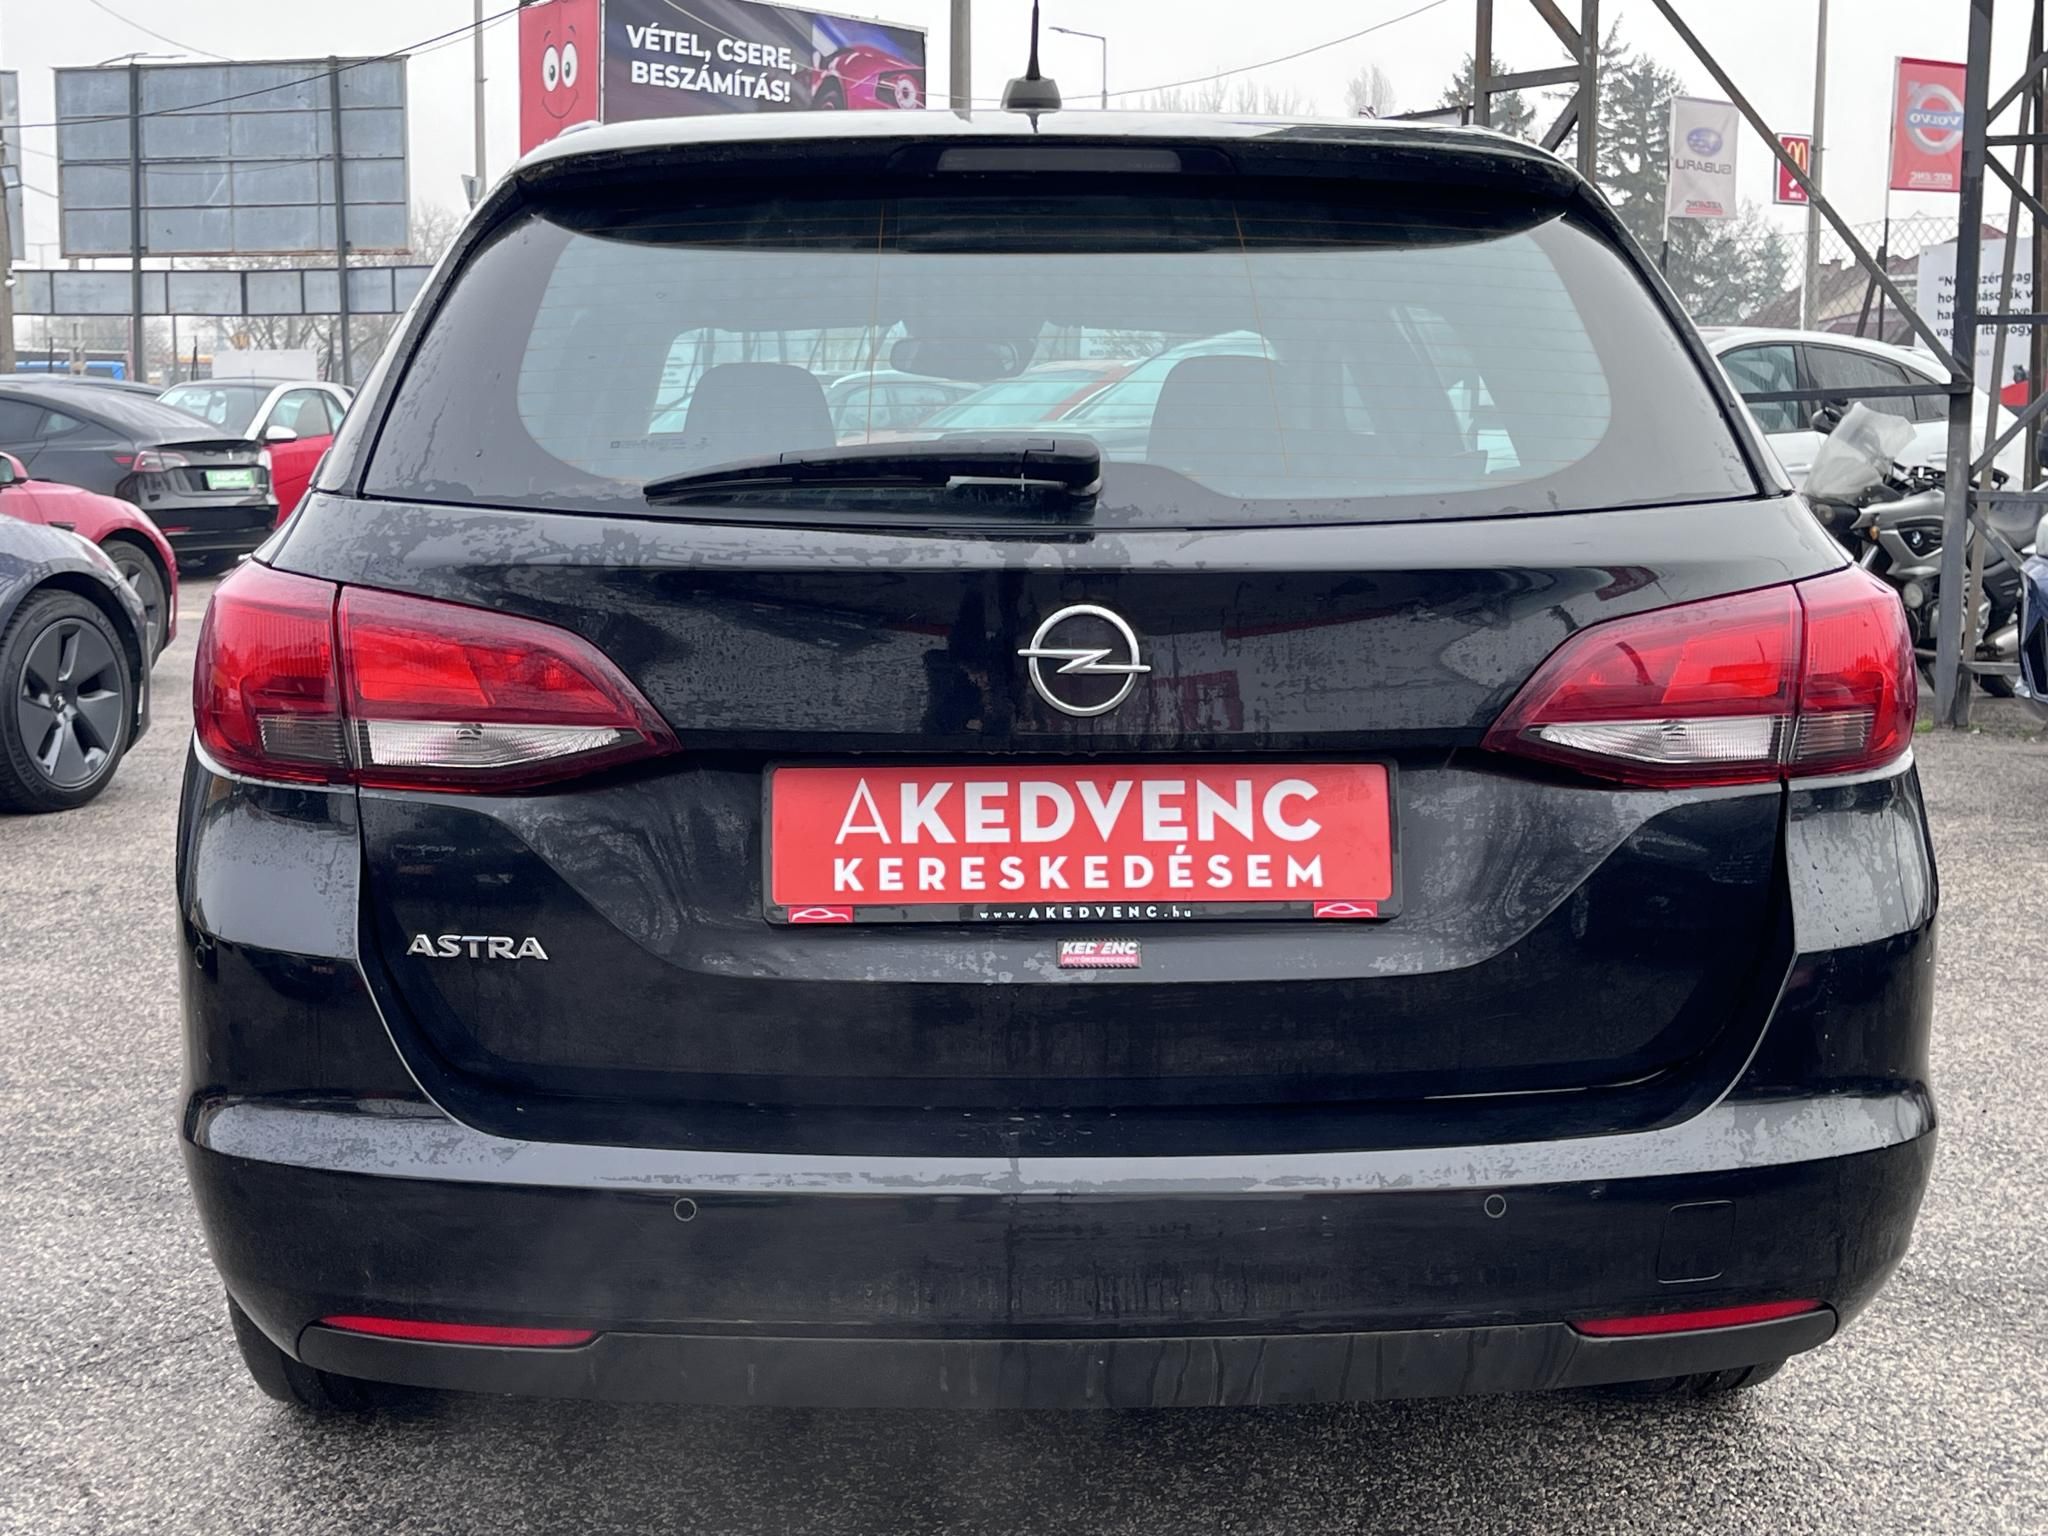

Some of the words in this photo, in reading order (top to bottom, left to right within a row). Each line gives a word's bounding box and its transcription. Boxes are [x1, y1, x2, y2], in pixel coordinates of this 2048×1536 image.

[626, 22, 712, 62] VÉTEL,
[717, 38, 798, 75] CSERE,
[631, 60, 792, 103] BESZÁMÍTÁS!
[833, 845, 1323, 892] KERESKEDÉSEM
[980, 905, 1192, 919] www.AKEDVENC.hu
[406, 934, 549, 960] ASTRA
